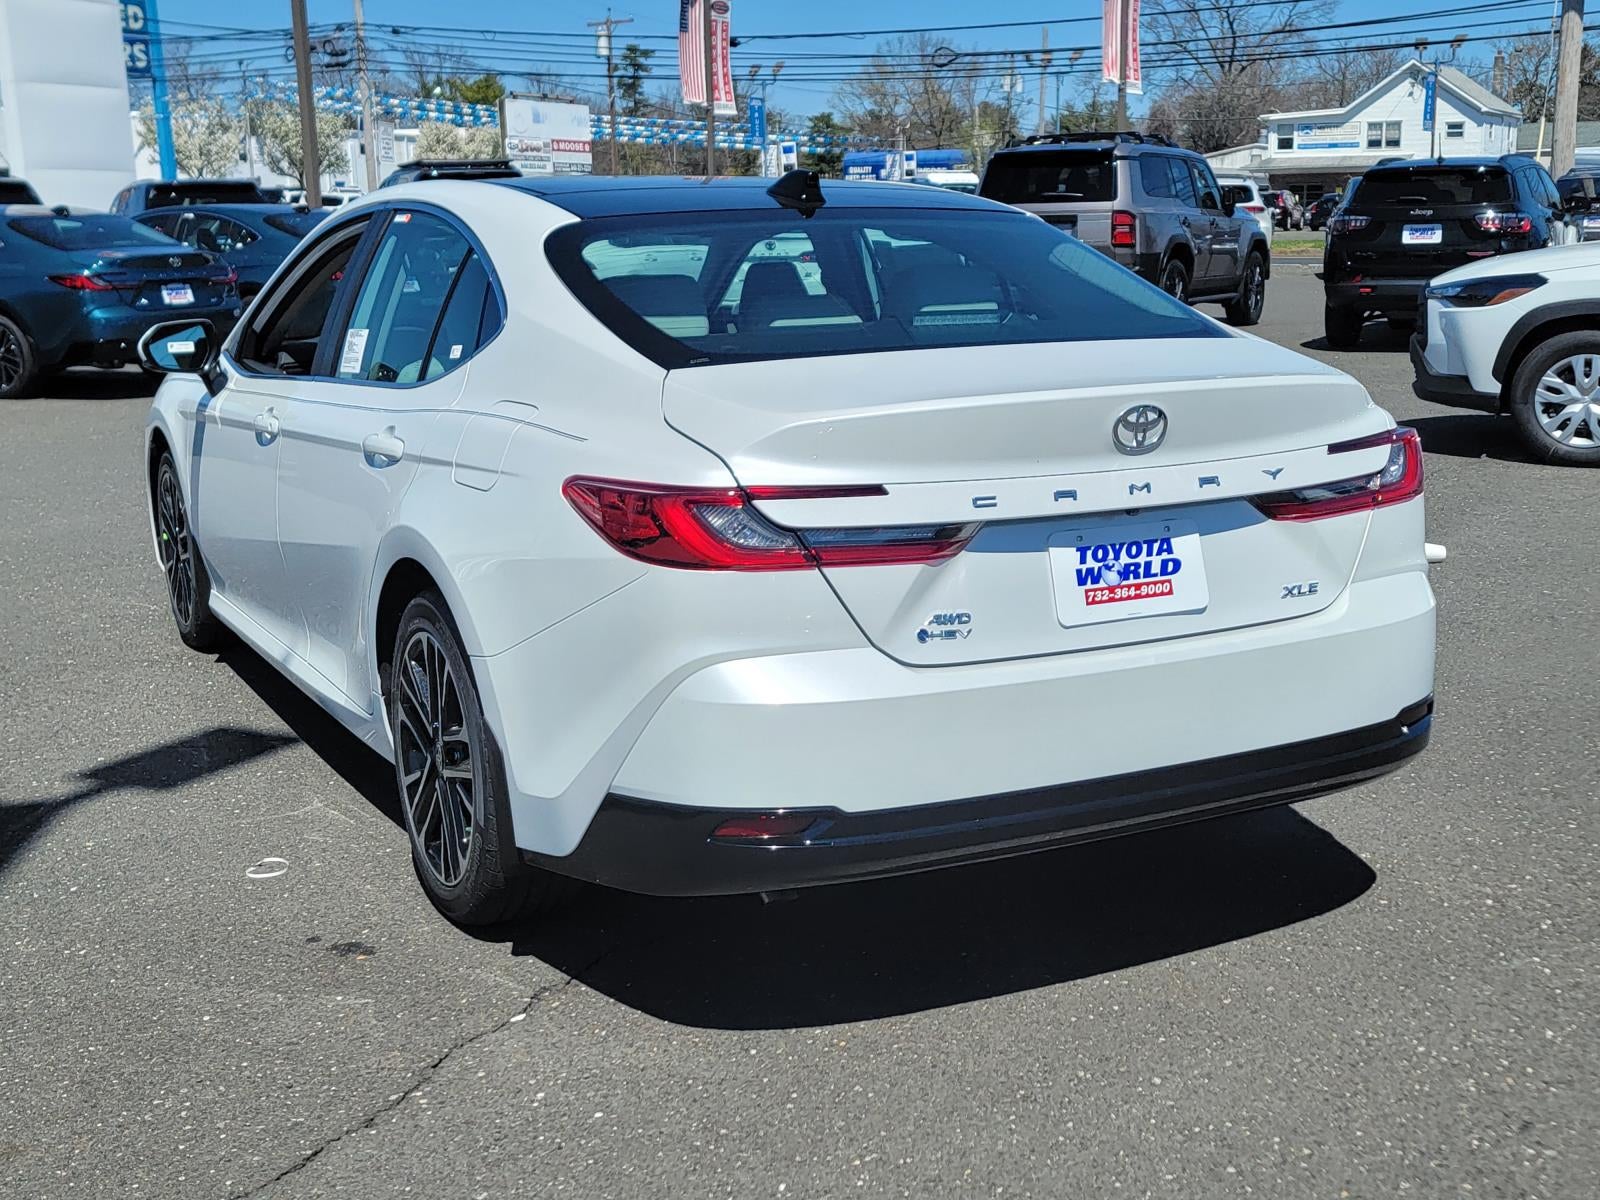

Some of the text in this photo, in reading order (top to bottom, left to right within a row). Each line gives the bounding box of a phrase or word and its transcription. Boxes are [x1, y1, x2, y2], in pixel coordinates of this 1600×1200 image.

[711, 22, 720, 98] TOYOTA
[722, 22, 732, 100] CERTIFIED
[559, 141, 584, 151] MOOSE
[849, 166, 872, 174] QUALITY
[1410, 208, 1433, 216] Jeep
[972, 467, 1284, 508] CAMRY
[1075, 537, 1174, 565] TOYOTA
[1087, 582, 1170, 603] 732-364-9000
[1281, 582, 1319, 599] XLE
[927, 612, 972, 626] AWD
